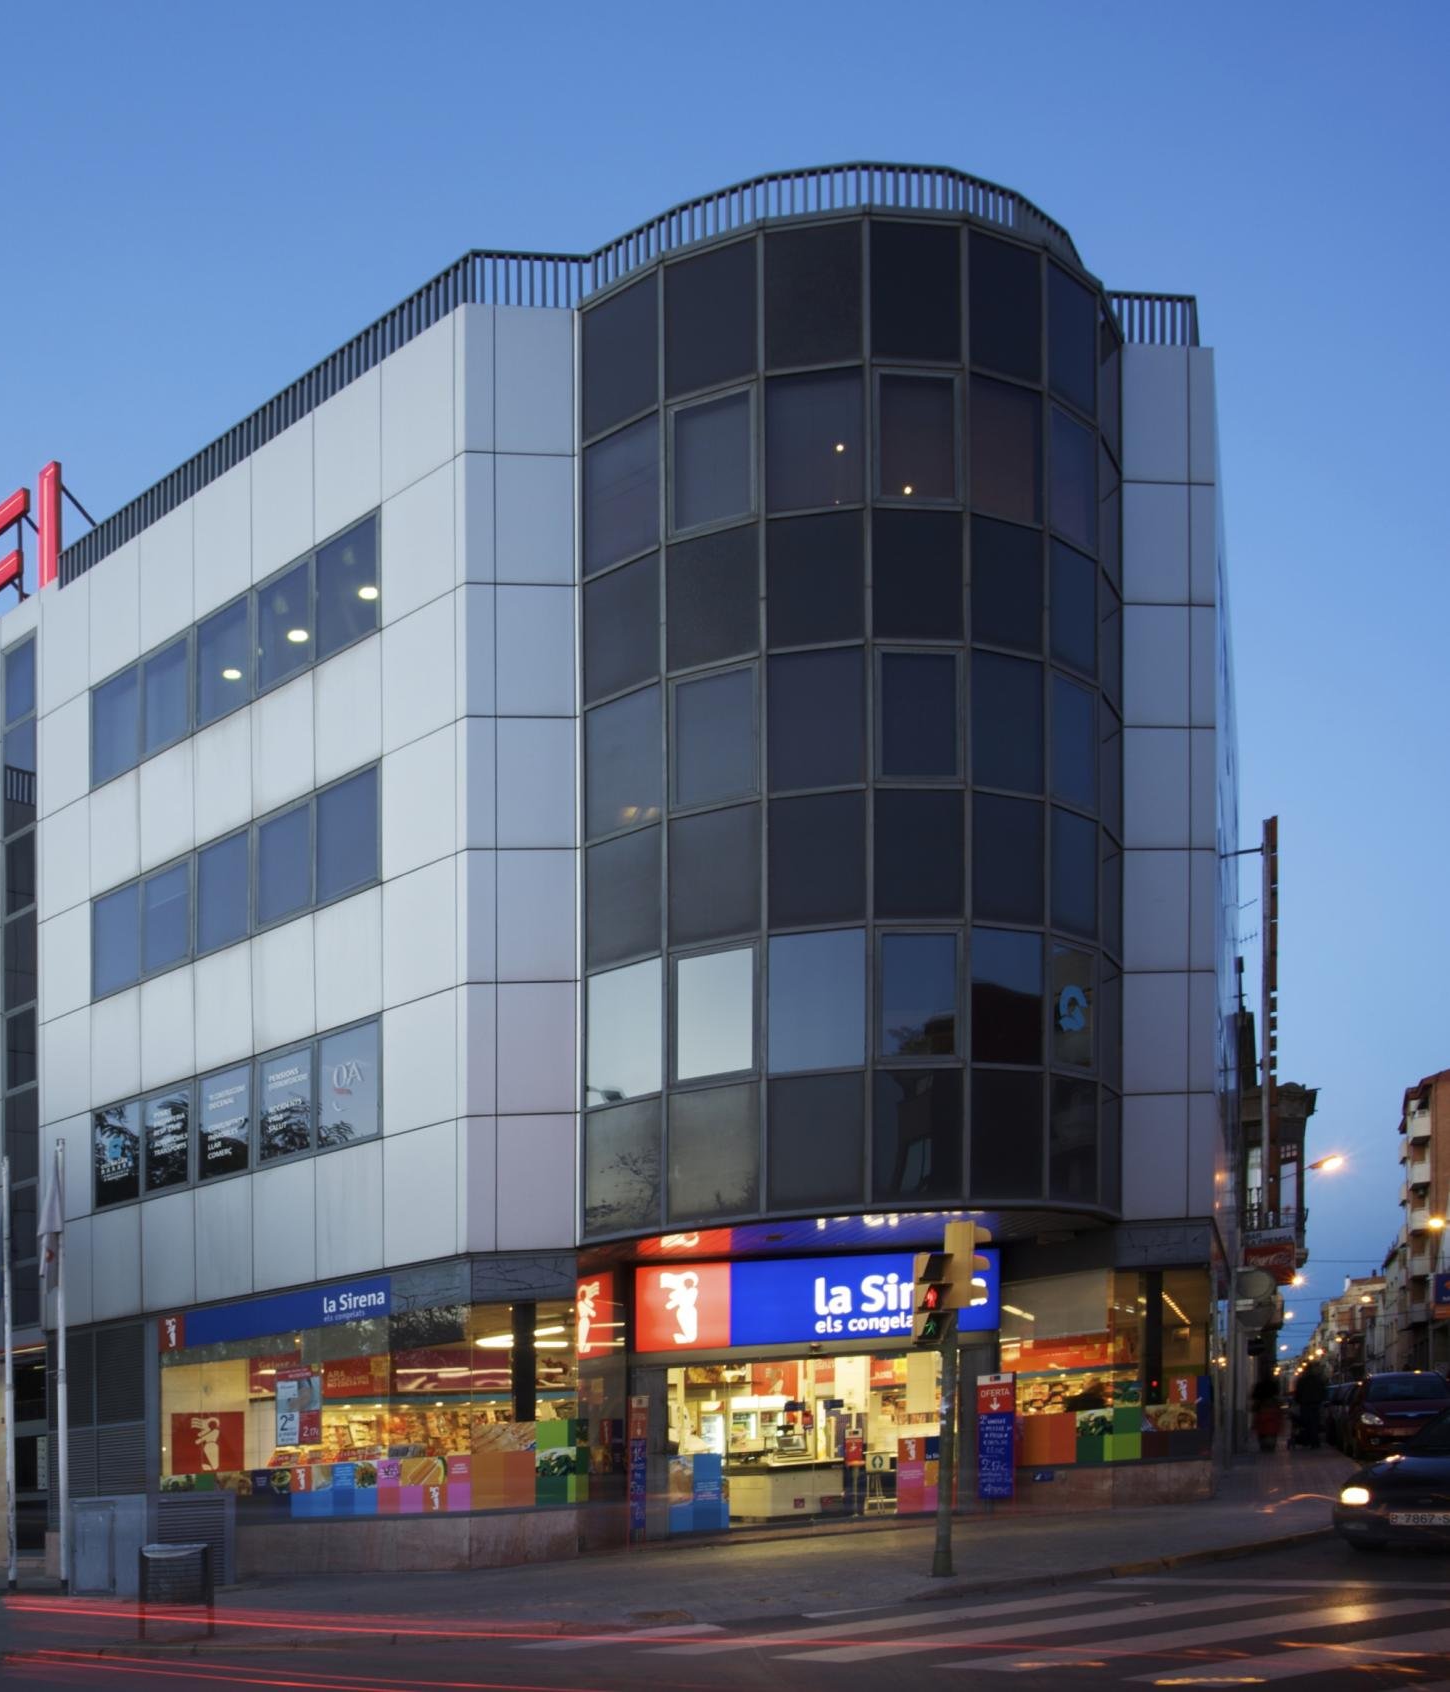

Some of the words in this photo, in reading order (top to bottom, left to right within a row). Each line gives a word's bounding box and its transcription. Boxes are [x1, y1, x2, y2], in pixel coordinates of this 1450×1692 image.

[323, 1297, 337, 1314] la
[339, 1291, 385, 1312] Sirena
[815, 1277, 852, 1316] la
[815, 1316, 842, 1334] els
[980, 1388, 1011, 1399] OFERTA
